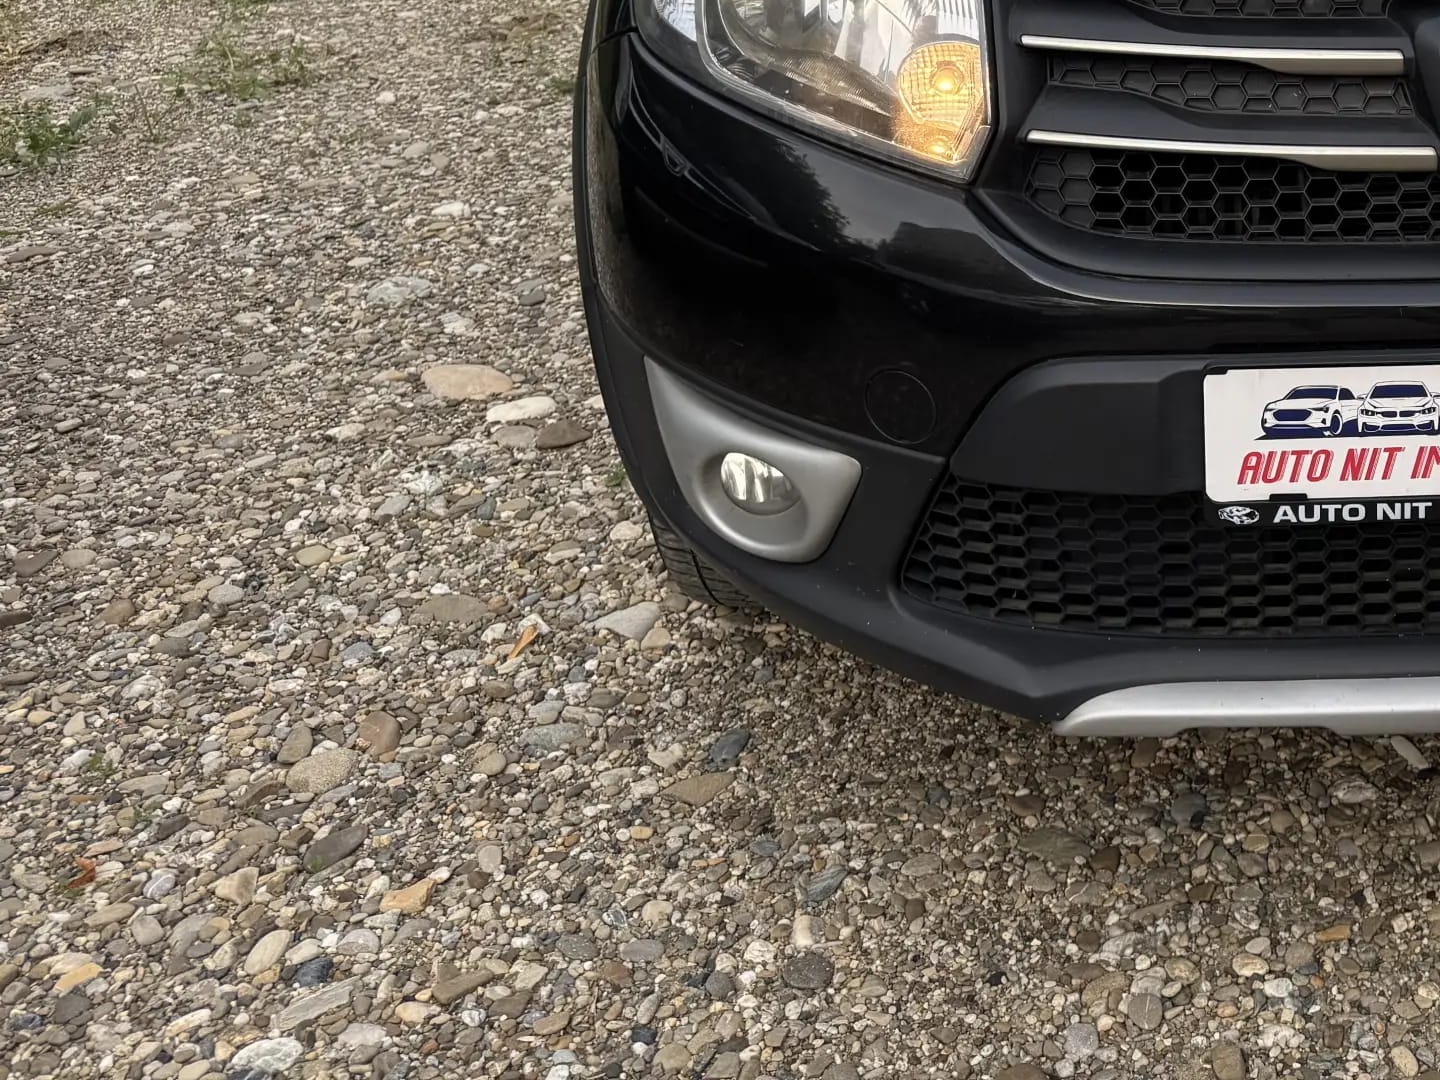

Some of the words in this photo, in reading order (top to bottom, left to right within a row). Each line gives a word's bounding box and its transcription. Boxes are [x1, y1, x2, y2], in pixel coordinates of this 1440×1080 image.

[1237, 449, 1334, 485] AUTO
[1339, 446, 1406, 482] NIT
[1273, 503, 1366, 524] AUTO
[1376, 501, 1432, 521] NIT
